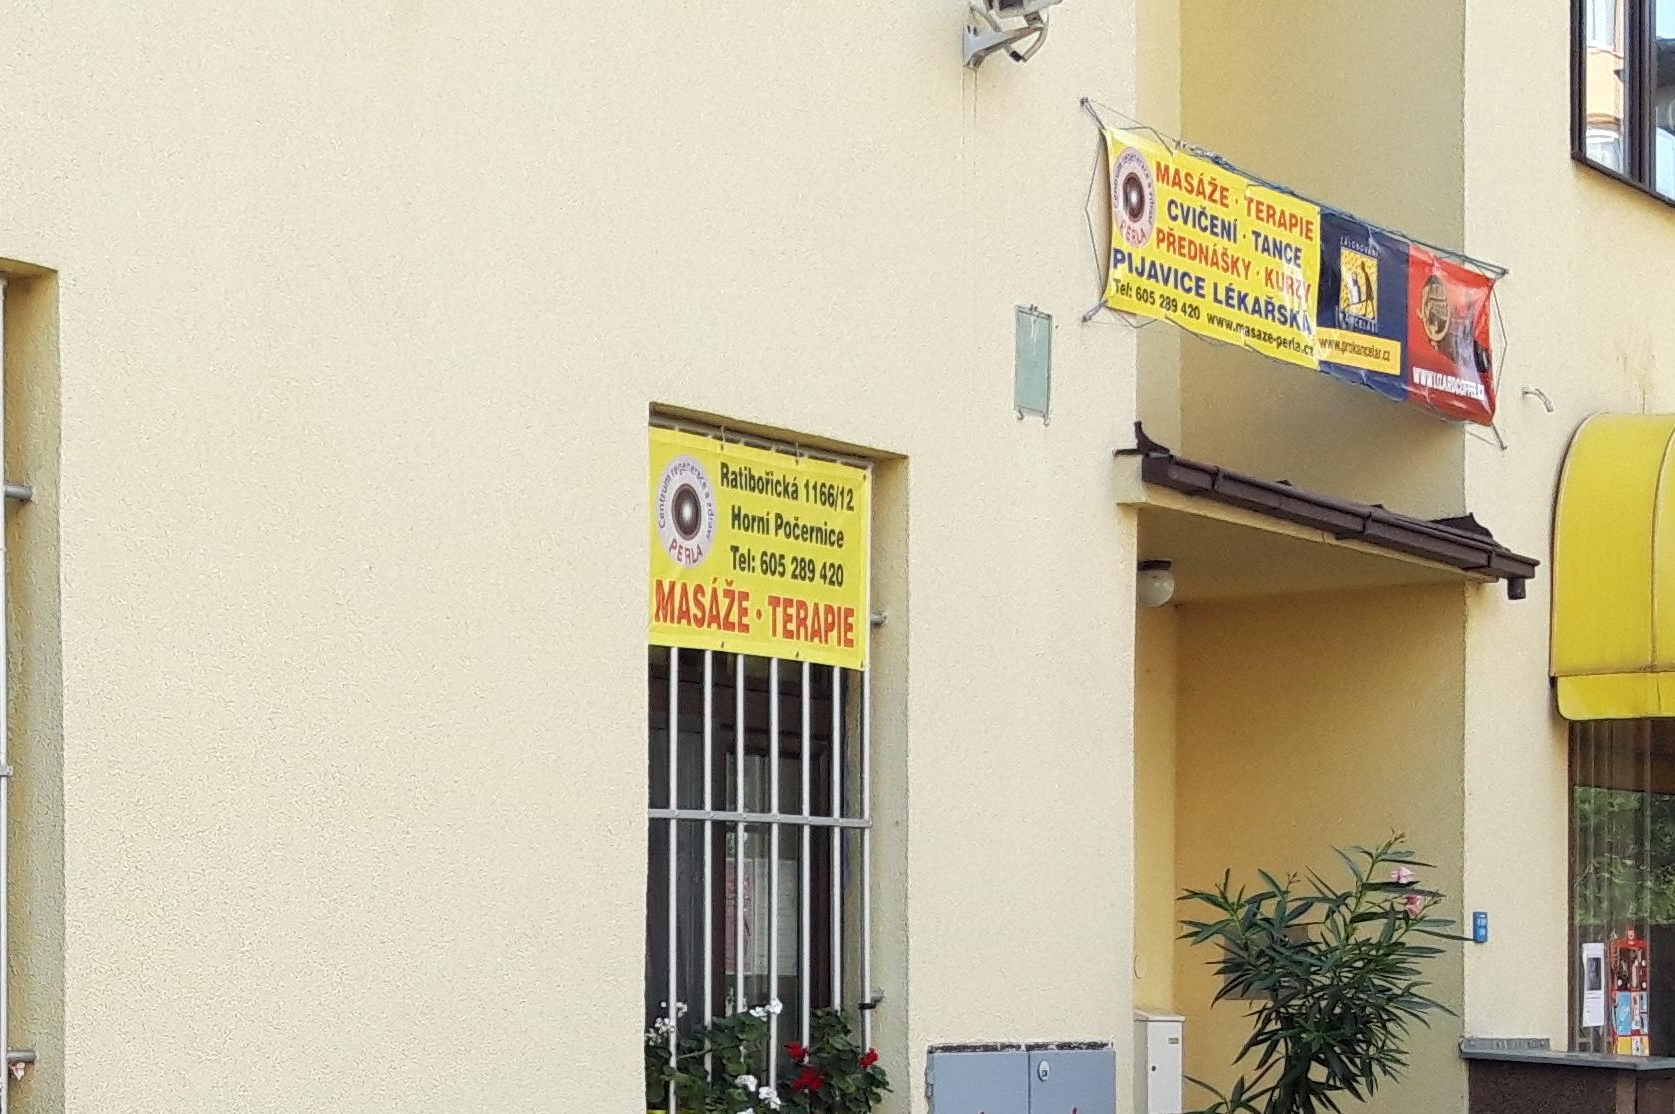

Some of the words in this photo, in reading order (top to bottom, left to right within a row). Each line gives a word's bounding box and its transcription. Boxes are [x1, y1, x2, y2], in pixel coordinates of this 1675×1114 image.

[1155, 160, 1231, 209] MASÁŽE
[1244, 197, 1315, 242] TERAPIE
[1167, 198, 1239, 245] CVIČENÍ
[1251, 230, 1303, 269] TANCE
[1112, 248, 1206, 299] PIJAVICE
[1155, 227, 1252, 281] PŘEDNÁŠKY
[1264, 266, 1312, 304] KURZY
[1113, 277, 1133, 297] Tel:
[1135, 286, 1156, 306] 605
[1181, 302, 1201, 321] 420
[720, 462, 800, 502] Ratibořická
[803, 479, 856, 512] 1166/12
[668, 538, 704, 565] PERLA
[730, 505, 771, 535] Horní
[775, 512, 845, 549] Počernice
[730, 545, 756, 574] Tel:
[760, 550, 786, 579] 605
[790, 557, 816, 583] 289
[819, 563, 845, 588] 420
[654, 577, 751, 634] MASÁŽE
[767, 595, 856, 649] TERAPIE
